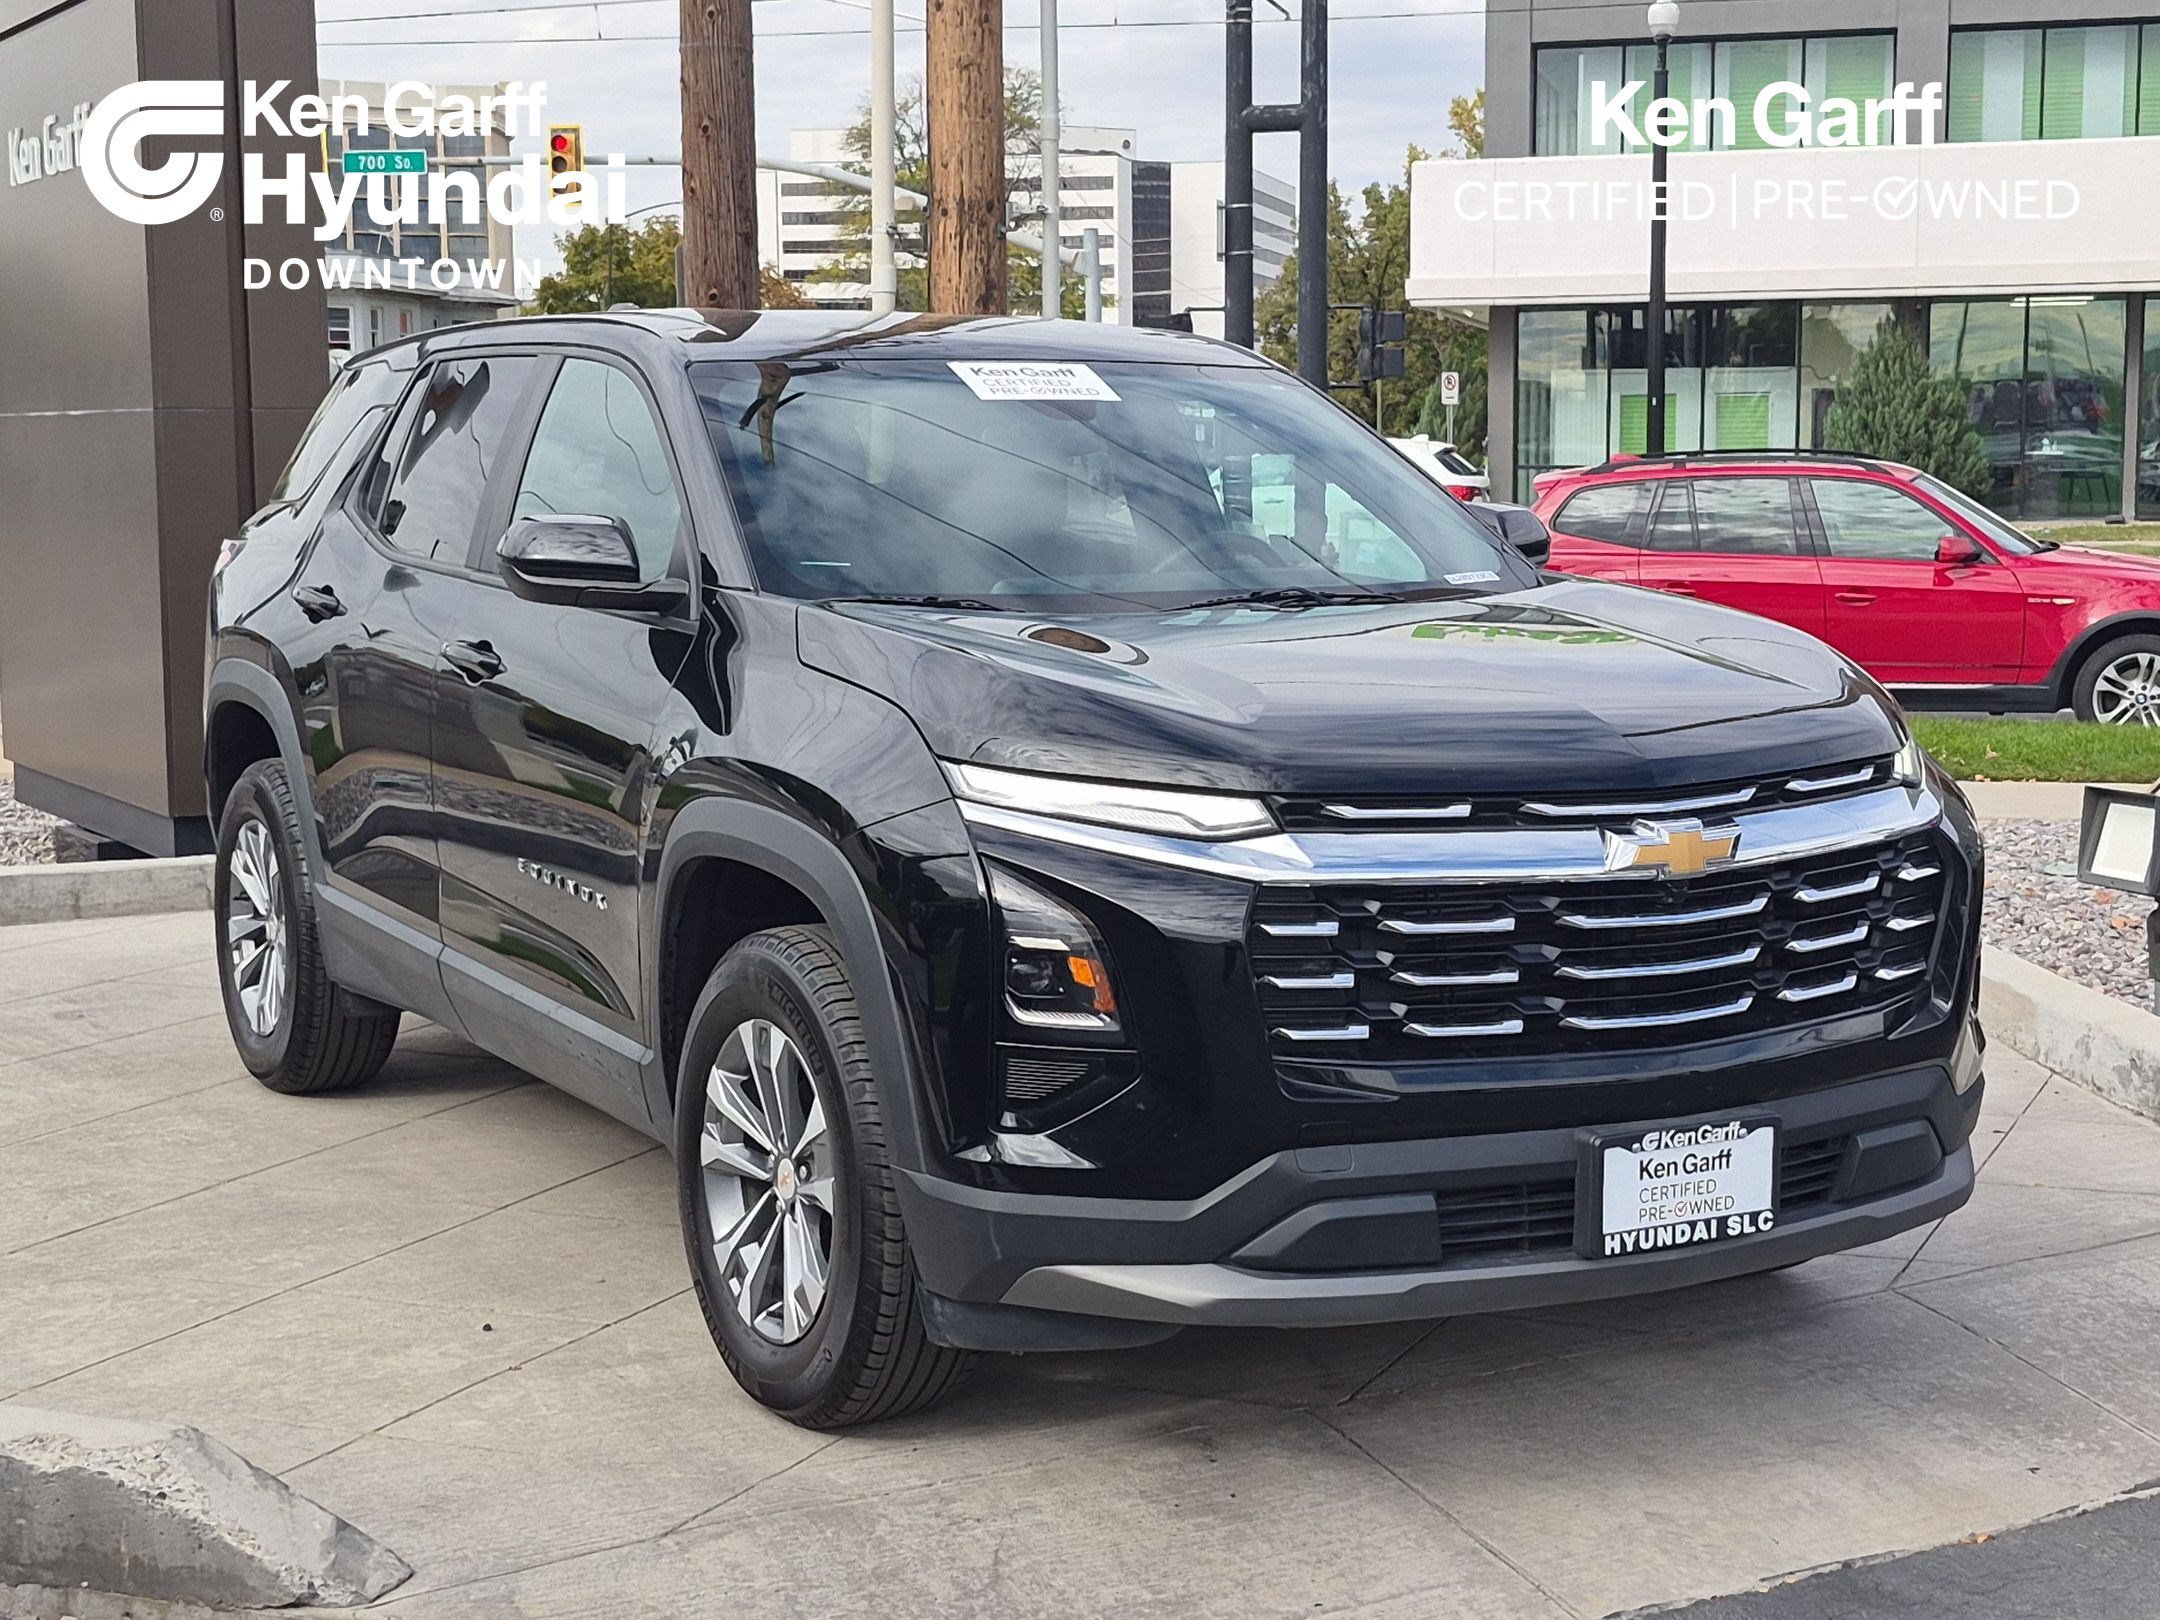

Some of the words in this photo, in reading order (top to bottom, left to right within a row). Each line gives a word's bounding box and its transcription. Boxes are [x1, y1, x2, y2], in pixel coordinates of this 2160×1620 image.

[8, 127, 42, 187] Ken
[358, 155, 386, 170] 700
[969, 366, 1017, 377] Ken
[1019, 367, 1076, 378] Garff
[982, 378, 1071, 387] CERTIFIED
[1639, 1158, 1679, 1181] Ken
[1683, 1148, 1732, 1175] Garff
[1639, 1179, 1717, 1204] CERTIFIED
[1639, 1195, 1735, 1223] PRE-OWNED
[1604, 1219, 1718, 1255] HYUNDAI
[1726, 1210, 1774, 1236] SLC
